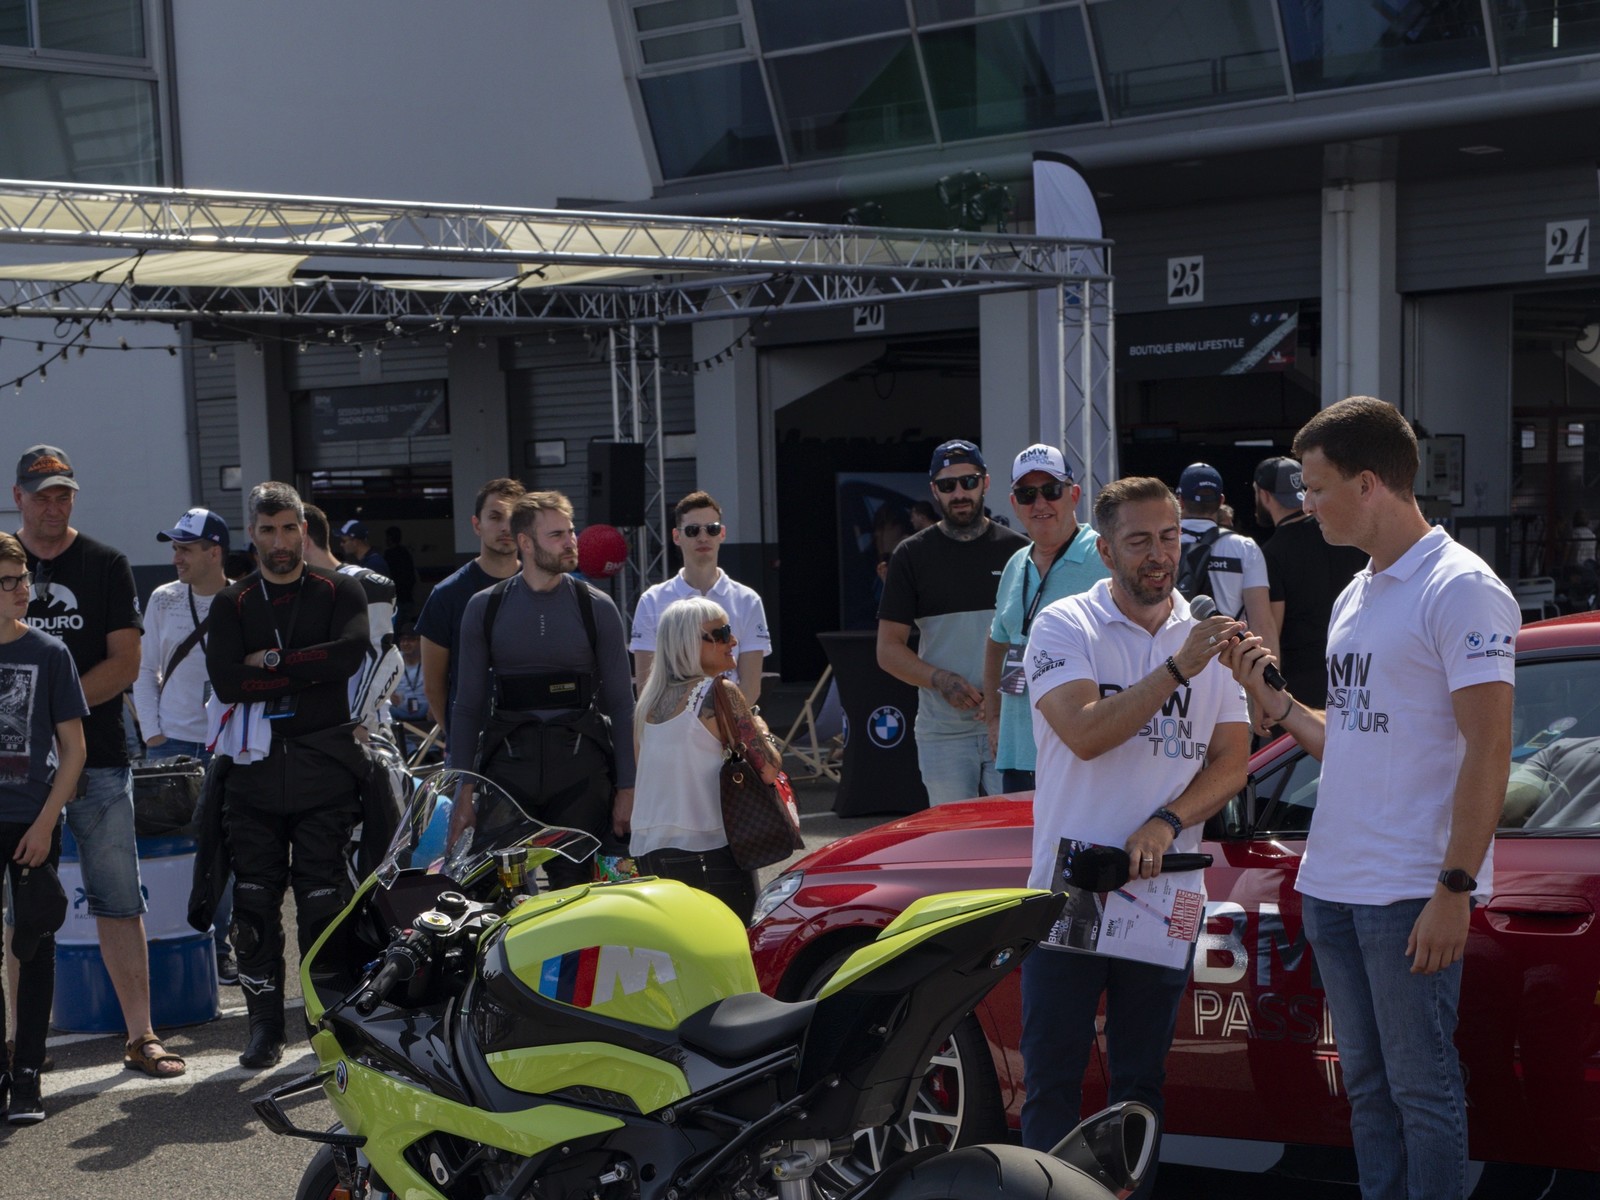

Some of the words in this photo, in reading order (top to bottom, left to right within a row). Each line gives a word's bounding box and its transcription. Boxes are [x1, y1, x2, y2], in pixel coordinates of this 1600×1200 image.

[1547, 226, 1588, 266] 24
[1170, 262, 1201, 298] 25
[1129, 343, 1174, 356] BOUTIQUE
[1174, 341, 1197, 353] BMW
[1198, 338, 1245, 351] LIFESTYLE
[1020, 448, 1049, 462] BMW
[1208, 561, 1228, 569] port
[20, 614, 84, 630] NDURO
[1031, 660, 1066, 682] MICHELIN
[1326, 652, 1372, 688] MW
[872, 708, 901, 720] BMW
[1340, 710, 1389, 734] TOUR
[1, 734, 24, 743] TOKYO
[1149, 736, 1208, 761] TOUR
[1168, 895, 1185, 939] SPEAKER
[1182, 897, 1201, 941] ANIMATEUR
[1193, 989, 1335, 1046] PASSI
